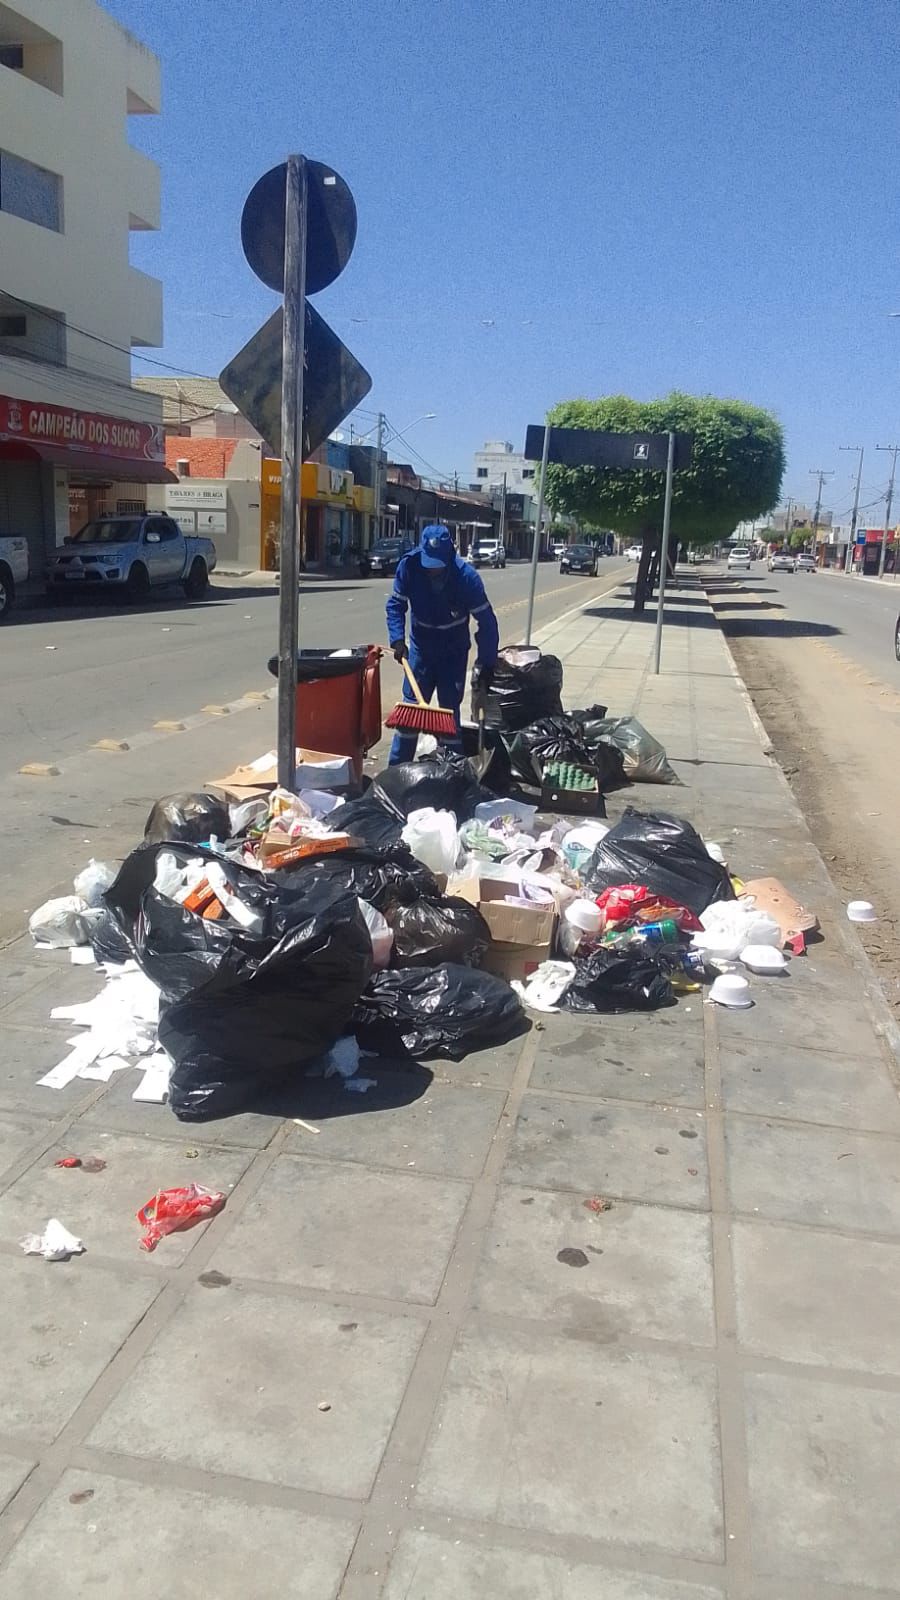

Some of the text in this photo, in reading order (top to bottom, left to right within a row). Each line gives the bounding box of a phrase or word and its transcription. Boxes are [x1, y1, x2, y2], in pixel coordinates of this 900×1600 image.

[29, 410, 85, 441] CAMPEÃO
[88, 421, 109, 445] DOS
[111, 424, 141, 449] SUCOS
